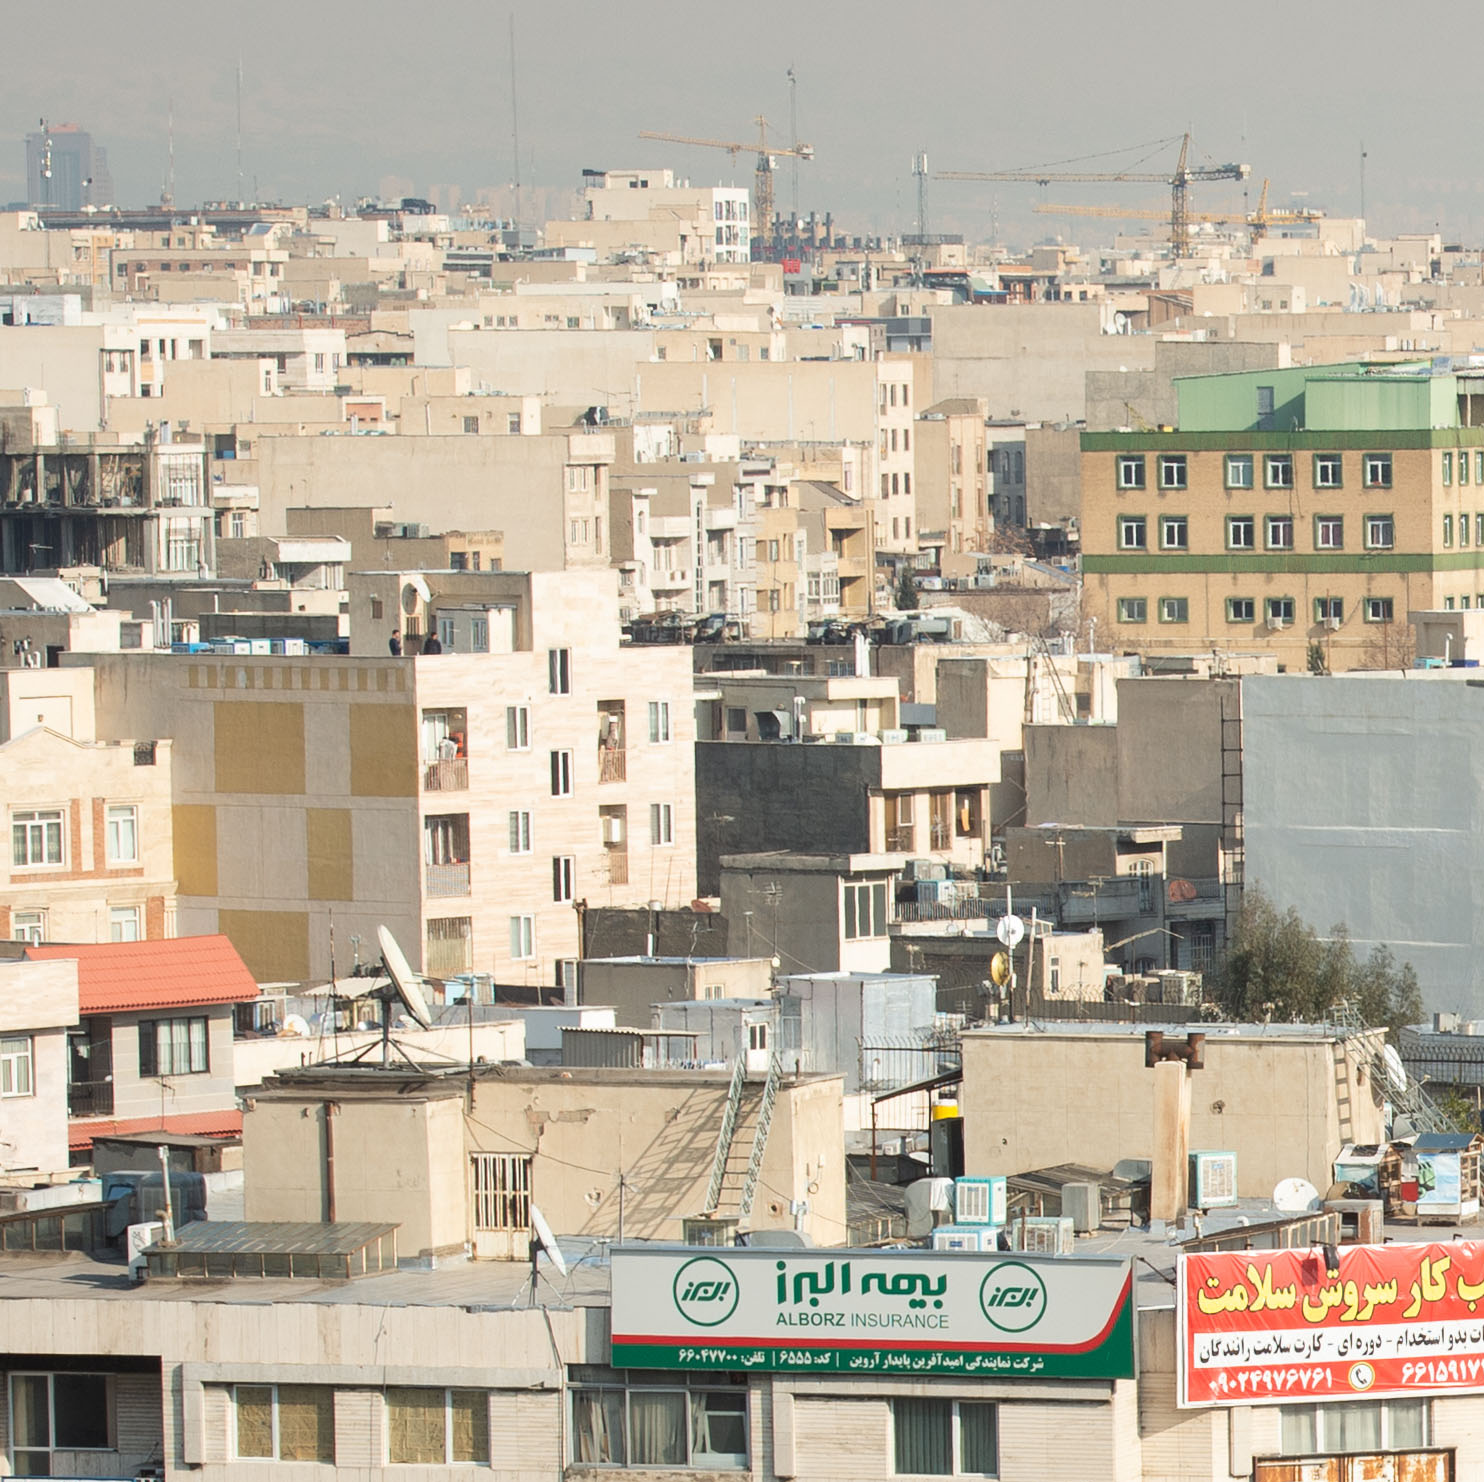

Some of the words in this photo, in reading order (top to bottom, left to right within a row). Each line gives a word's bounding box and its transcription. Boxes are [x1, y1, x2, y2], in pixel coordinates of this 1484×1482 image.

[776, 1260, 851, 1307] البرز
[861, 1274, 948, 1309] بیمه
[1197, 1262, 1297, 1316] سلامت
[1402, 1256, 1451, 1319] کار
[1301, 1268, 1399, 1323] سروش
[776, 1312, 846, 1327] ALBORZ
[850, 1313, 950, 1329] INSURANCE
[1253, 1334, 1292, 1357] سلامت
[1294, 1333, 1323, 1360] کارت
[1337, 1333, 1354, 1357] ای
[1355, 1335, 1383, 1356] دوره
[1396, 1326, 1446, 1349] استخدام
[1448, 1327, 1468, 1350] بدو
[678, 1349, 737, 1363] ۶۶۰۴۷۷۰۰
[779, 1350, 812, 1365] ۶۵۵۵
[849, 1352, 881, 1368] آروین
[882, 1354, 911, 1371] پایدار
[1199, 1338, 1250, 1364] رانندگان
[965, 1355, 1011, 1371] نمایندگی
[1013, 1356, 1044, 1372] شرکت
